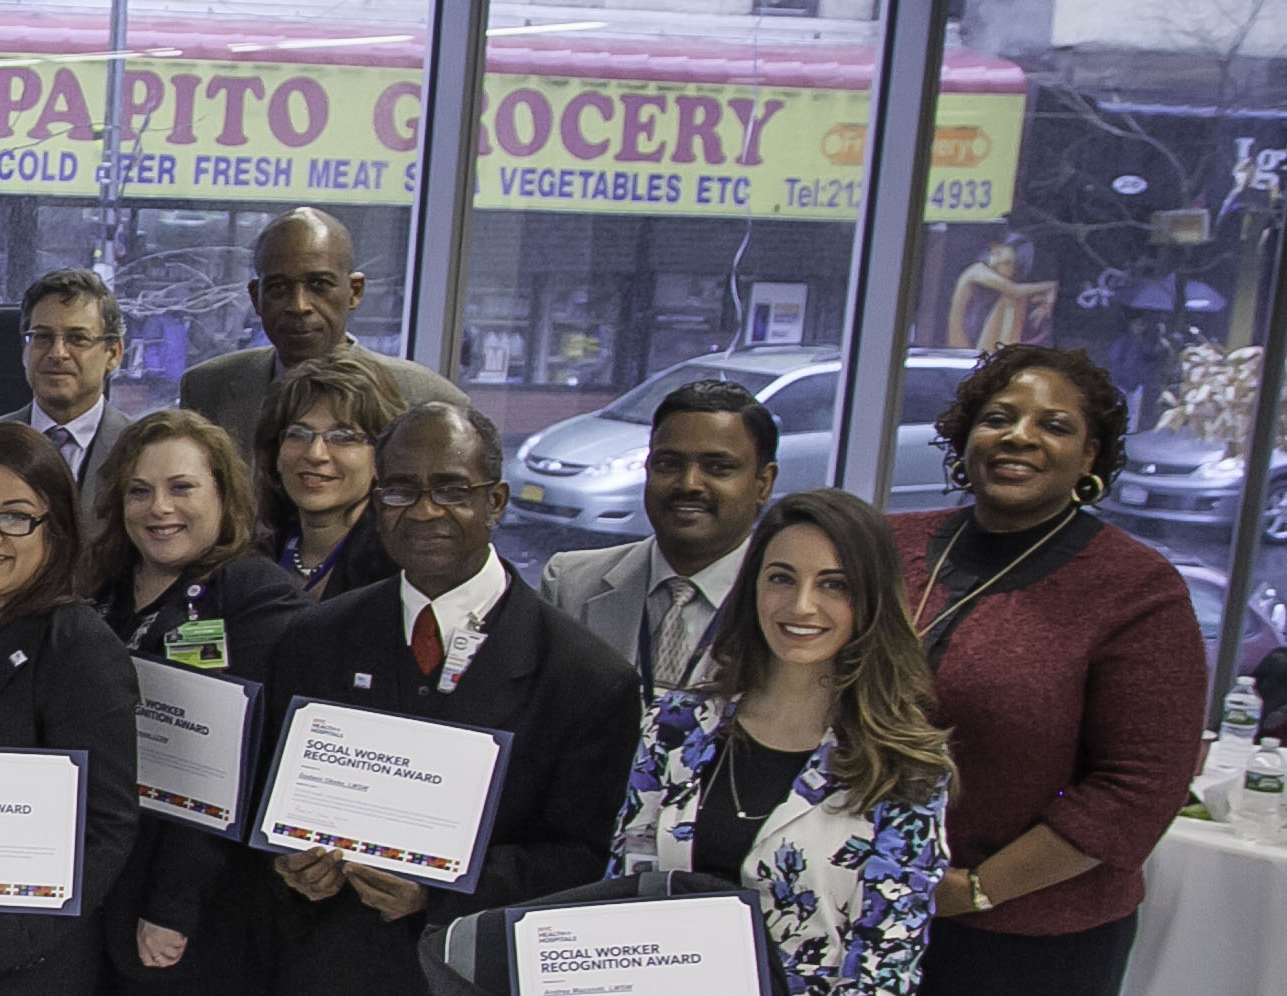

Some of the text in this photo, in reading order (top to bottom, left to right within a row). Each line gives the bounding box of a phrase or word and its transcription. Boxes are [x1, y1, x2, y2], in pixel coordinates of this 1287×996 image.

[194, 156, 292, 188] FRESH
[308, 158, 388, 190] MEAT
[500, 166, 682, 203] VEGETABLES
[696, 174, 750, 205] ETC
[146, 699, 185, 717] WORKER
[174, 718, 209, 735] AWARD
[306, 739, 410, 768] SOCIAL WORKER
[303, 750, 391, 775] RECOGNITION
[394, 766, 443, 785] AWARD
[540, 944, 660, 961] SOCIAL WORKER
[540, 953, 702, 973] RECOGNITION AWARD
